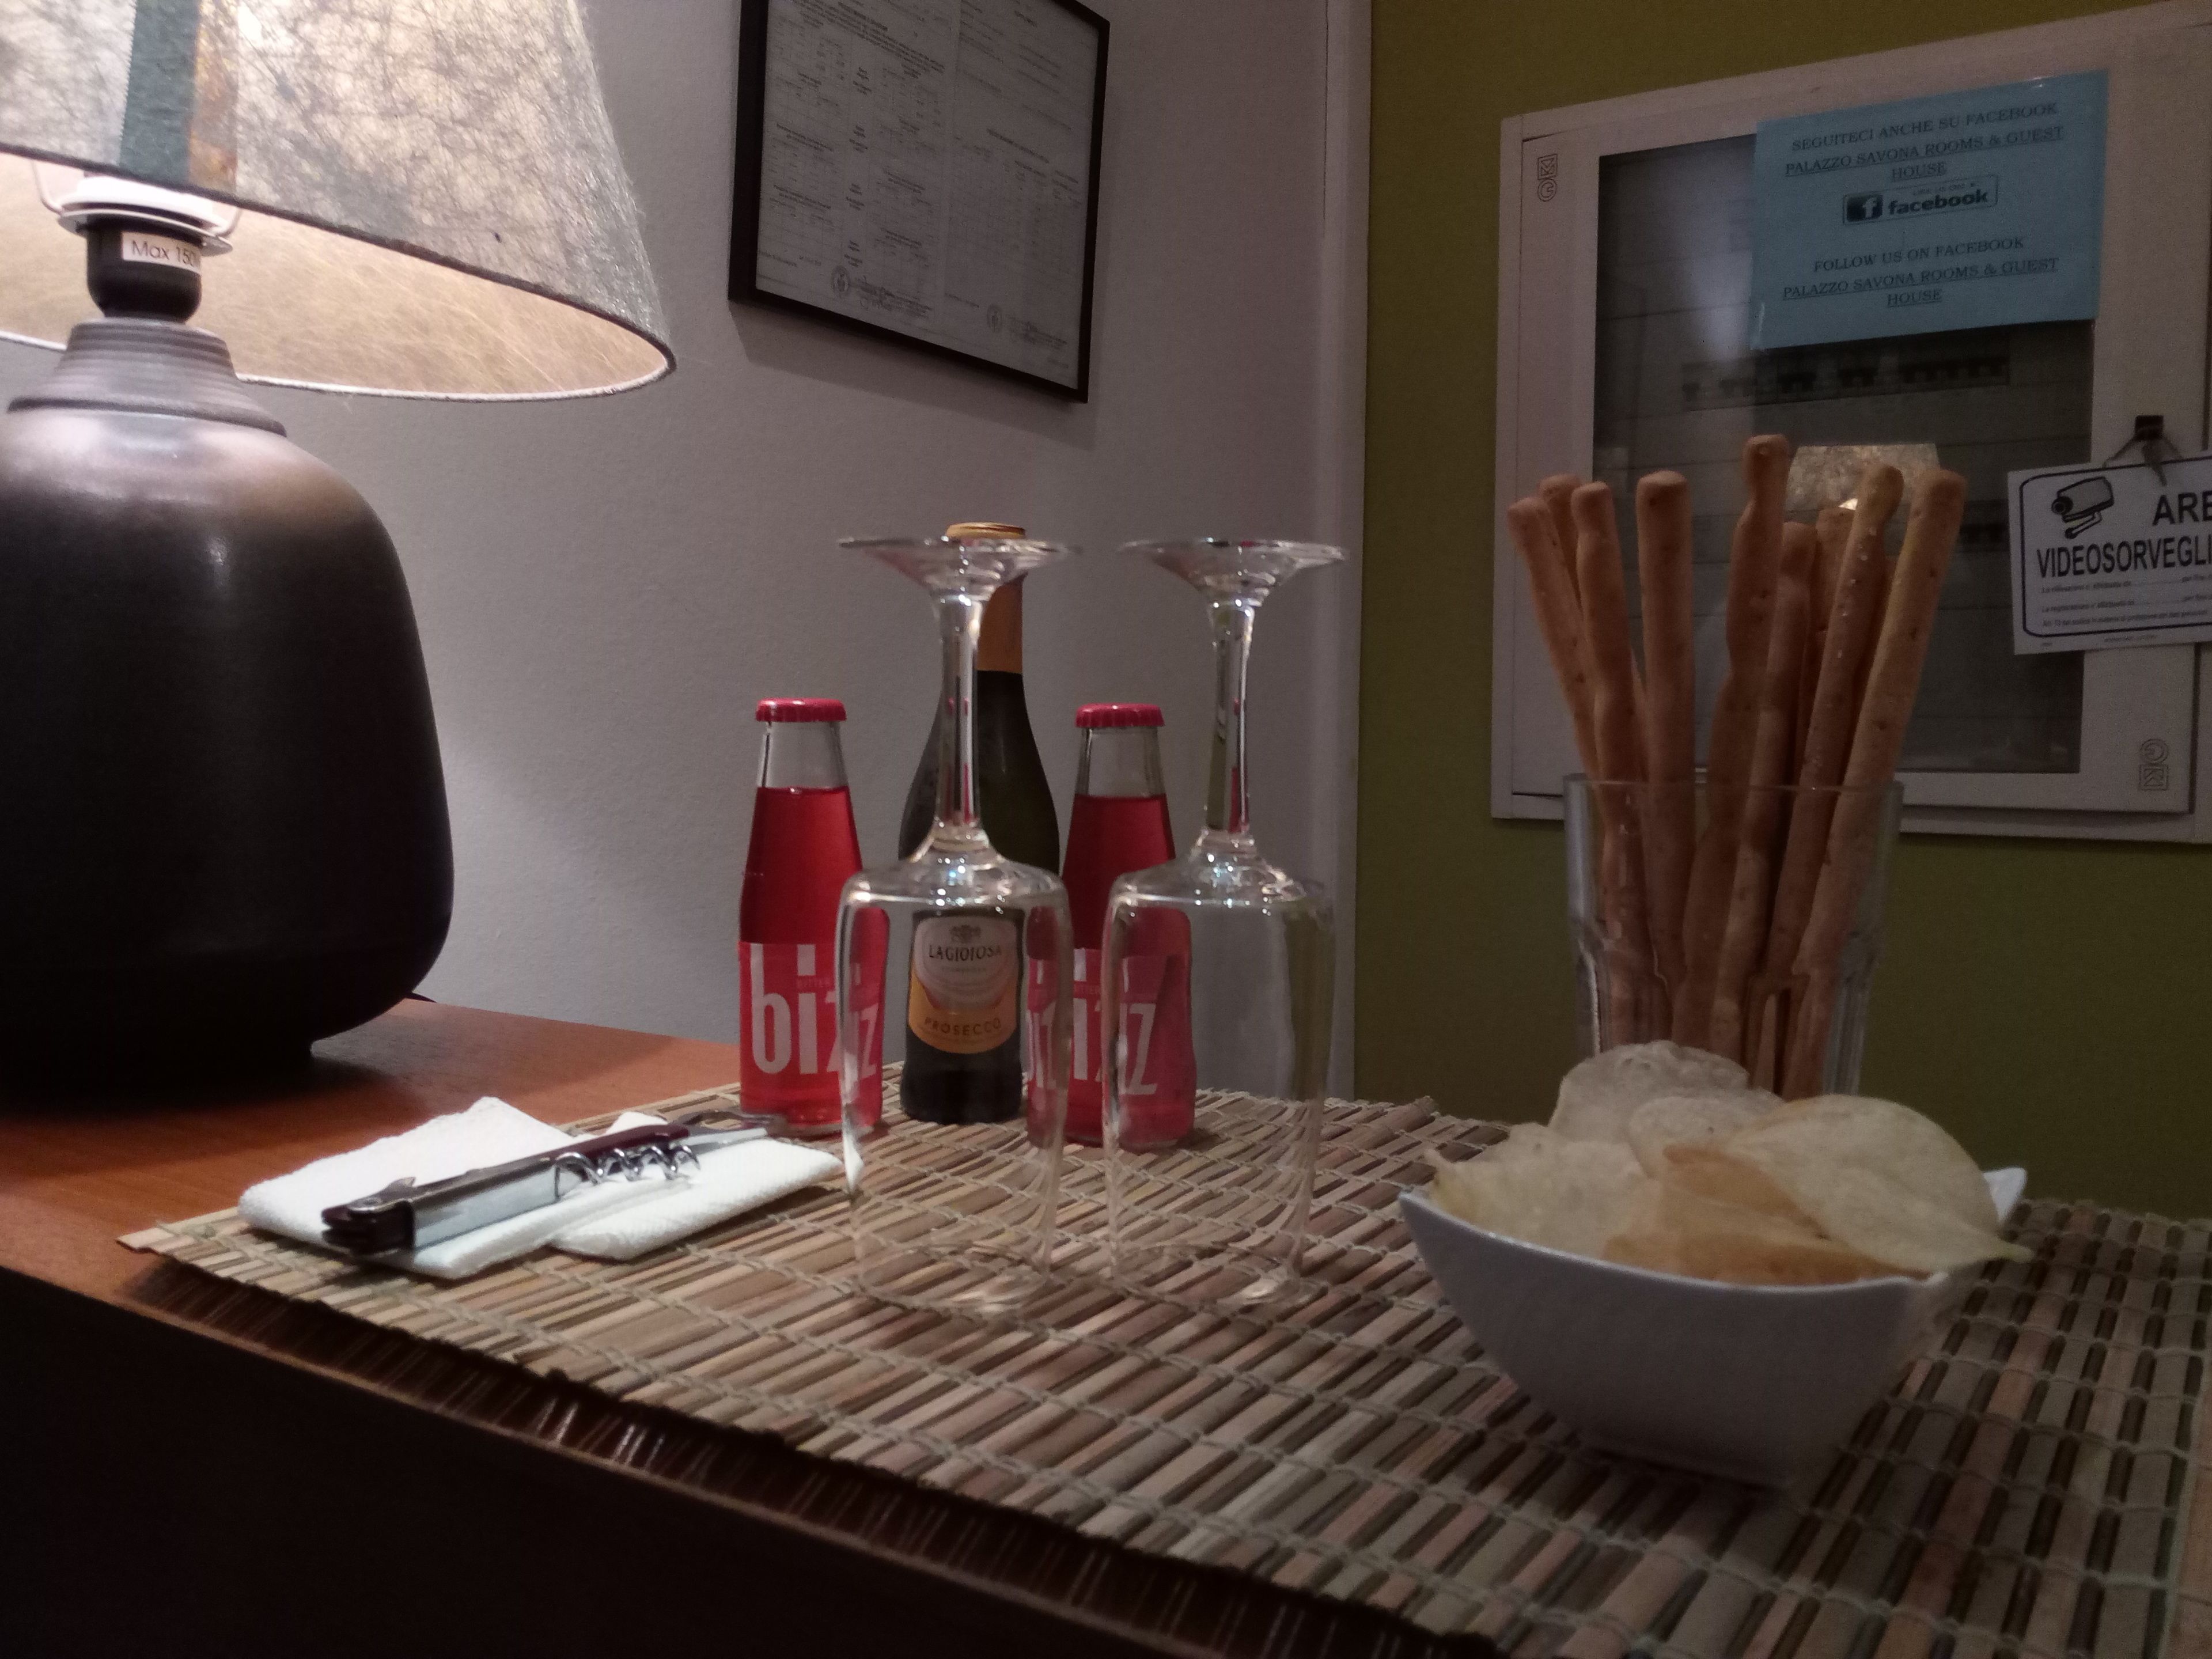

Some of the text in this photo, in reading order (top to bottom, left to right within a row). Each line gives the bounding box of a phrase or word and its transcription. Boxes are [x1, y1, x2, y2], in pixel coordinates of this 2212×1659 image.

[1792, 103, 2058, 151] SEGUITECI ANCHE SU FACEBOOK
[1785, 126, 2065, 175] PALAZZO SAVONA ROOMS & GUEST
[1891, 162, 1947, 181] HOUSE
[1888, 189, 1988, 215] facebook
[132, 240, 170, 261] Max
[1814, 236, 2025, 273] FOLLOW US ON FACEBOOK
[1783, 257, 2059, 299] PALAZZO SAVONA ROOMS & GUEST
[1887, 288, 1943, 306] HOUSE
[2152, 490, 2212, 527] ARE
[2036, 534, 2212, 579] VIDEOSORVEGLI
[925, 1016, 1001, 1036] PROSECCO
